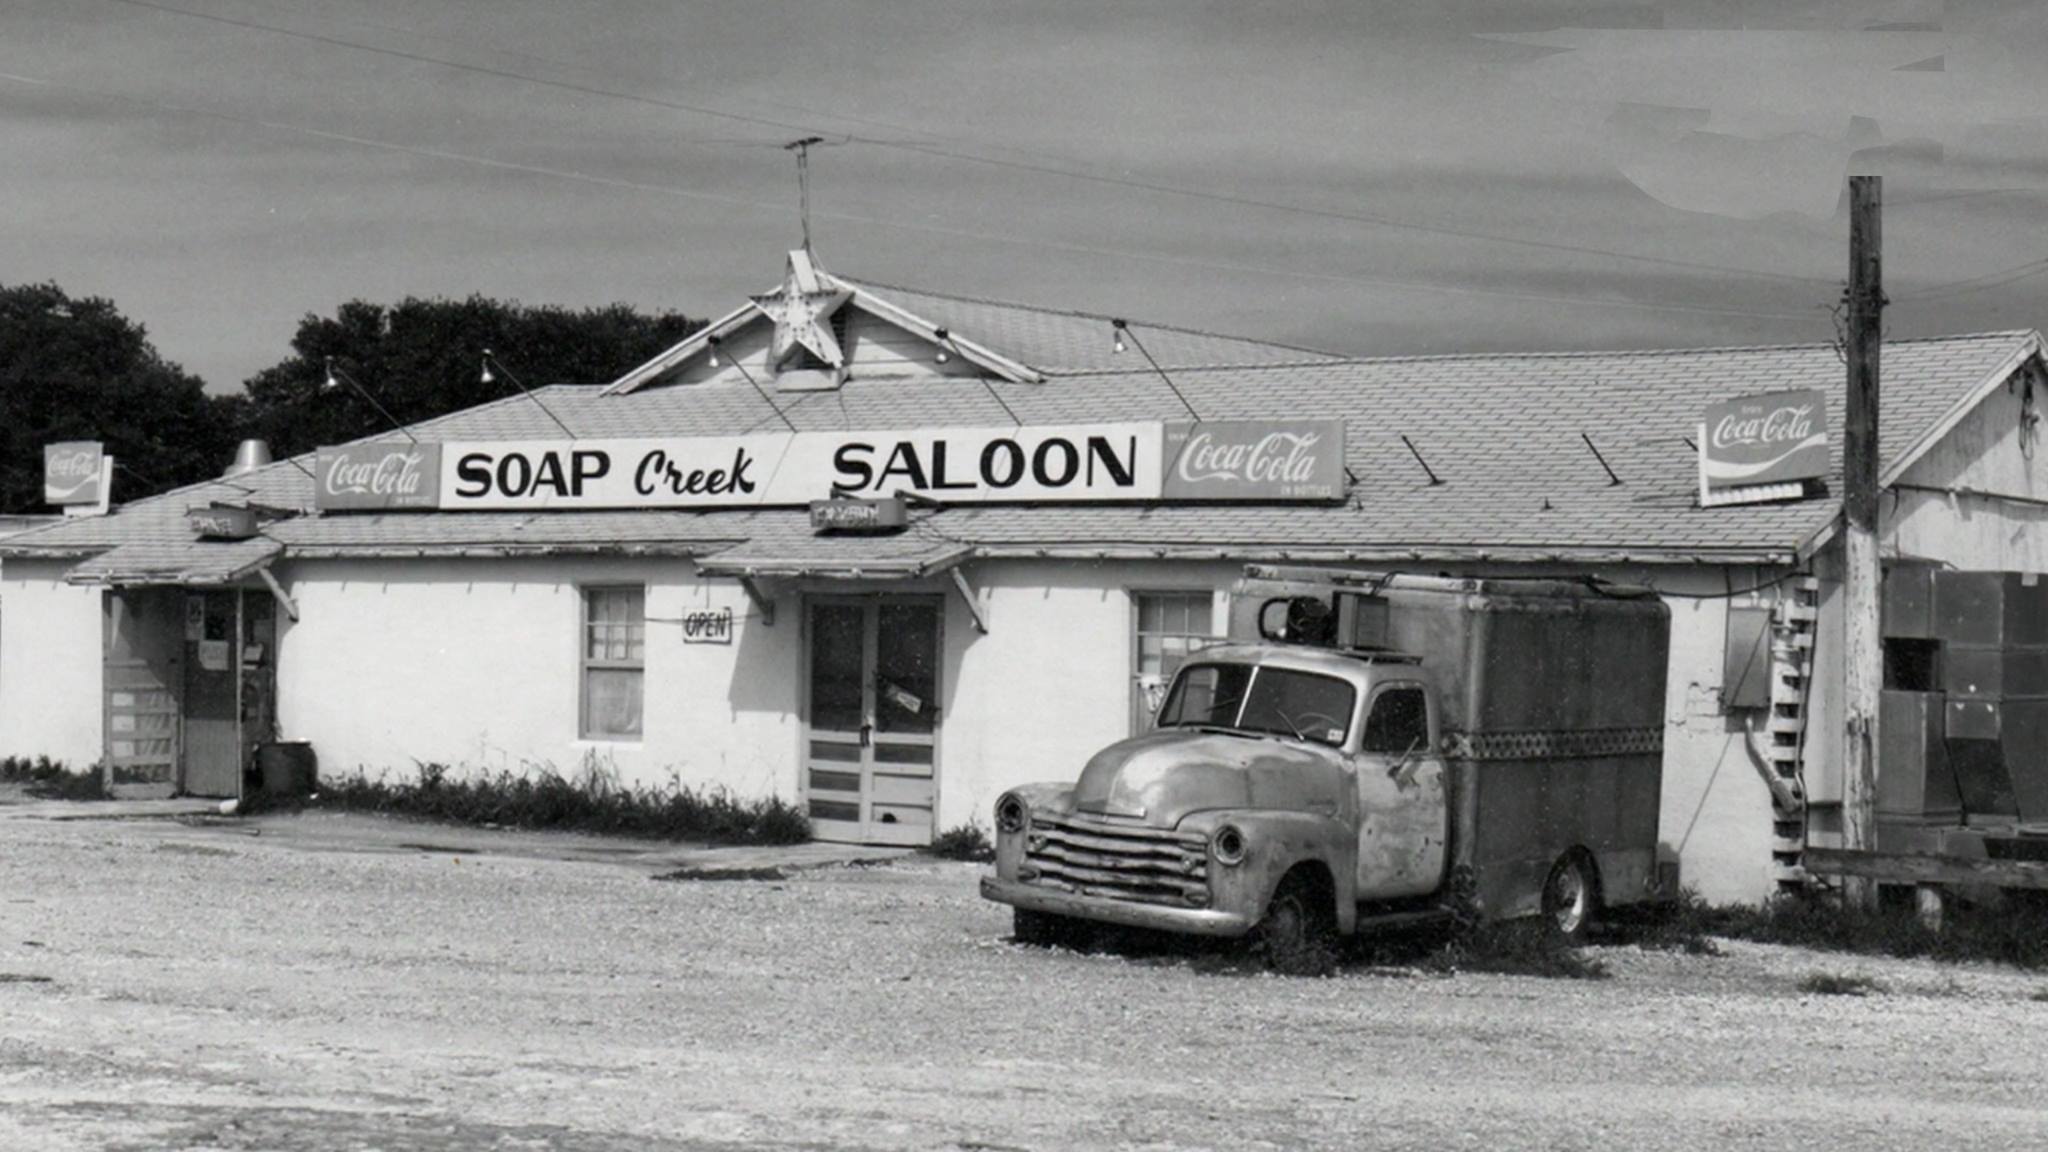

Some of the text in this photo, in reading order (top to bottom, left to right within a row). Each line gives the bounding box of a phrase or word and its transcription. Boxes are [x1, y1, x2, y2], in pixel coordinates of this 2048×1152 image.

[1713, 403, 1814, 448] Coca-Cola
[325, 452, 424, 495] Coca-Cola
[456, 436, 1136, 498] SOAP Creek SALOON
[1179, 432, 1322, 483] Coca-Cola
[685, 612, 727, 637] OPEN
